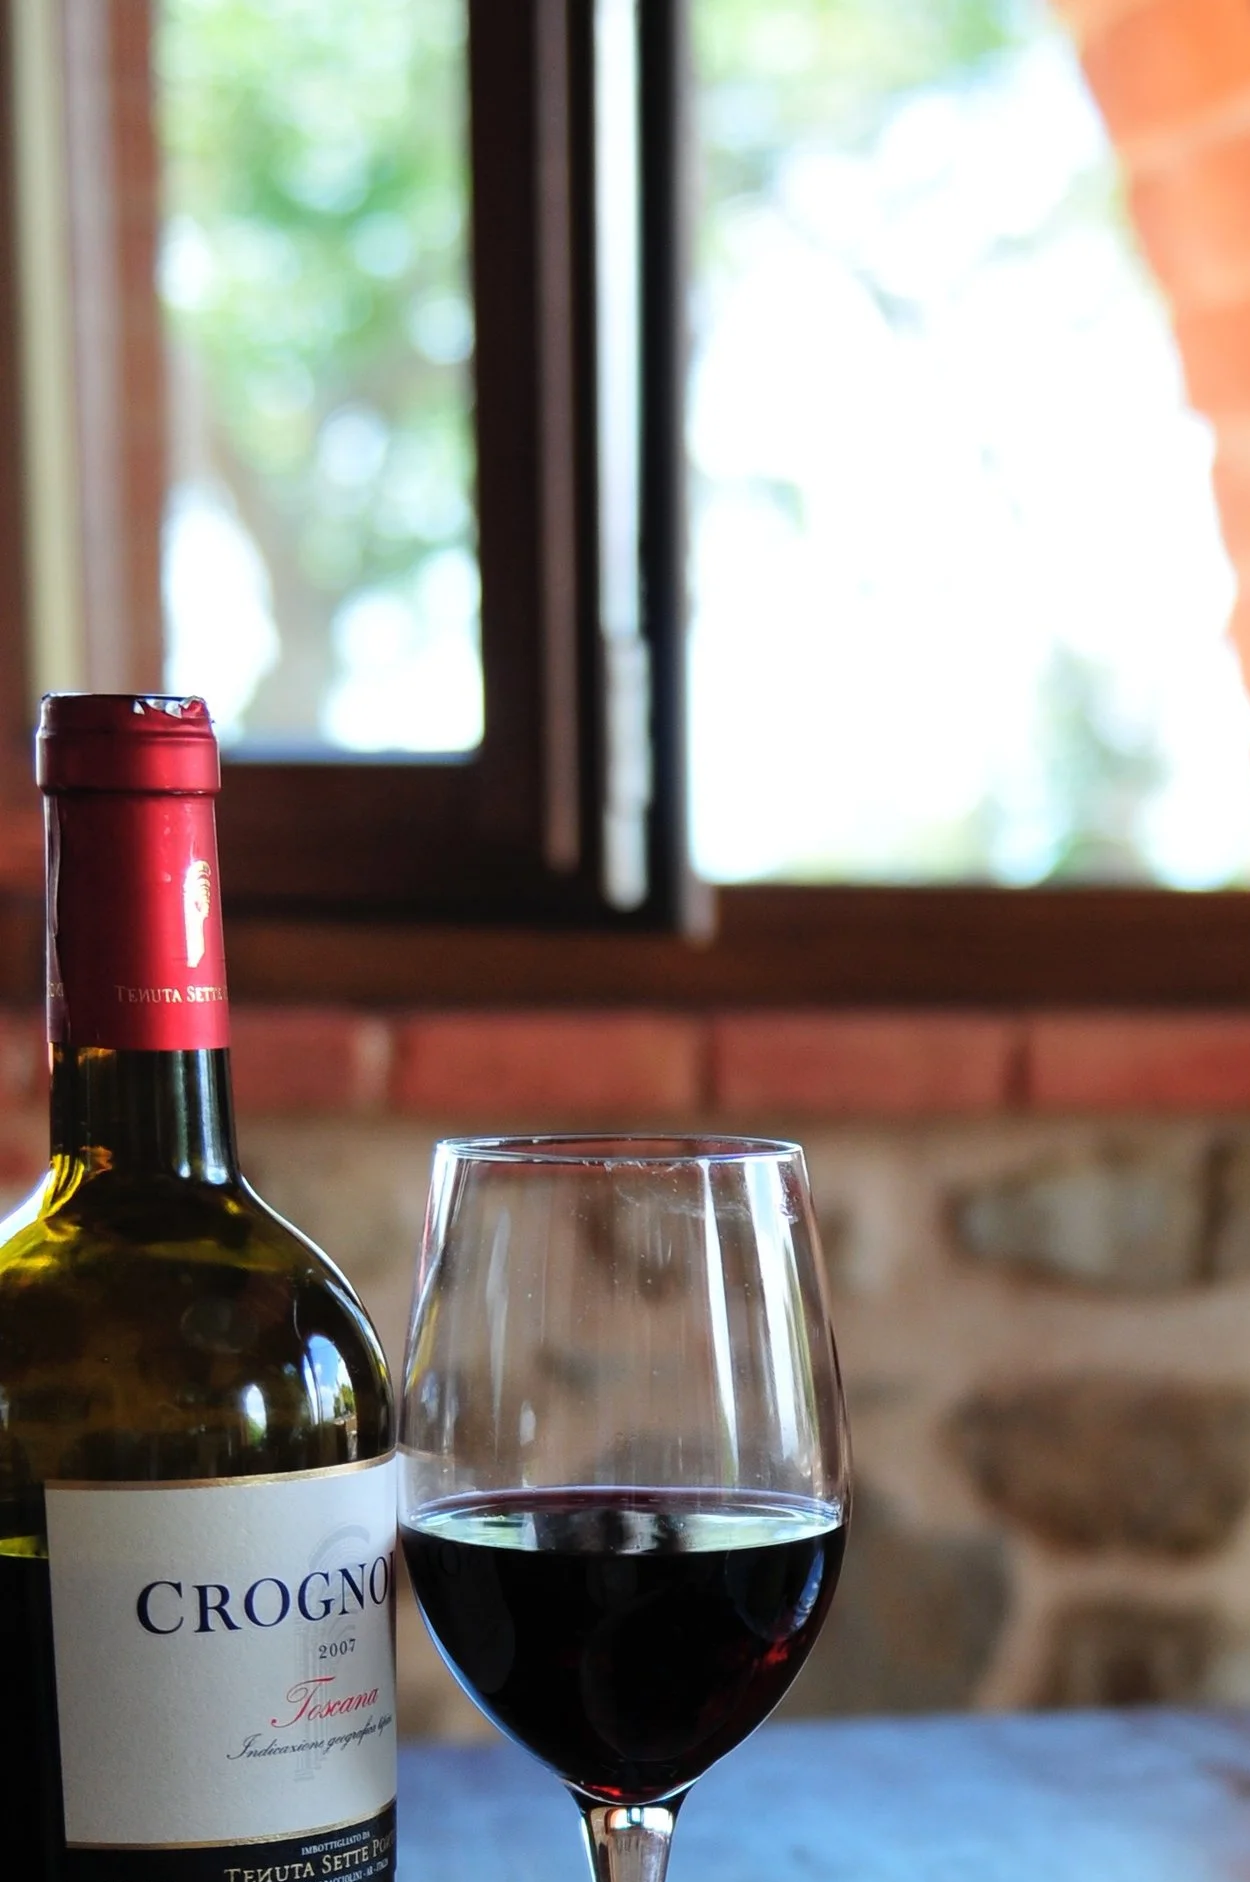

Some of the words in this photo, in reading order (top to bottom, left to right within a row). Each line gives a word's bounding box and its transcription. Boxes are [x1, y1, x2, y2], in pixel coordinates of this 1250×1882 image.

[114, 984, 183, 1003] TENUTA
[318, 1638, 356, 1659] 2007
[270, 1676, 379, 1729] Toscana
[301, 1832, 362, 1856] IMBOTTIGLIATO
[321, 1845, 369, 1874] SETTE
